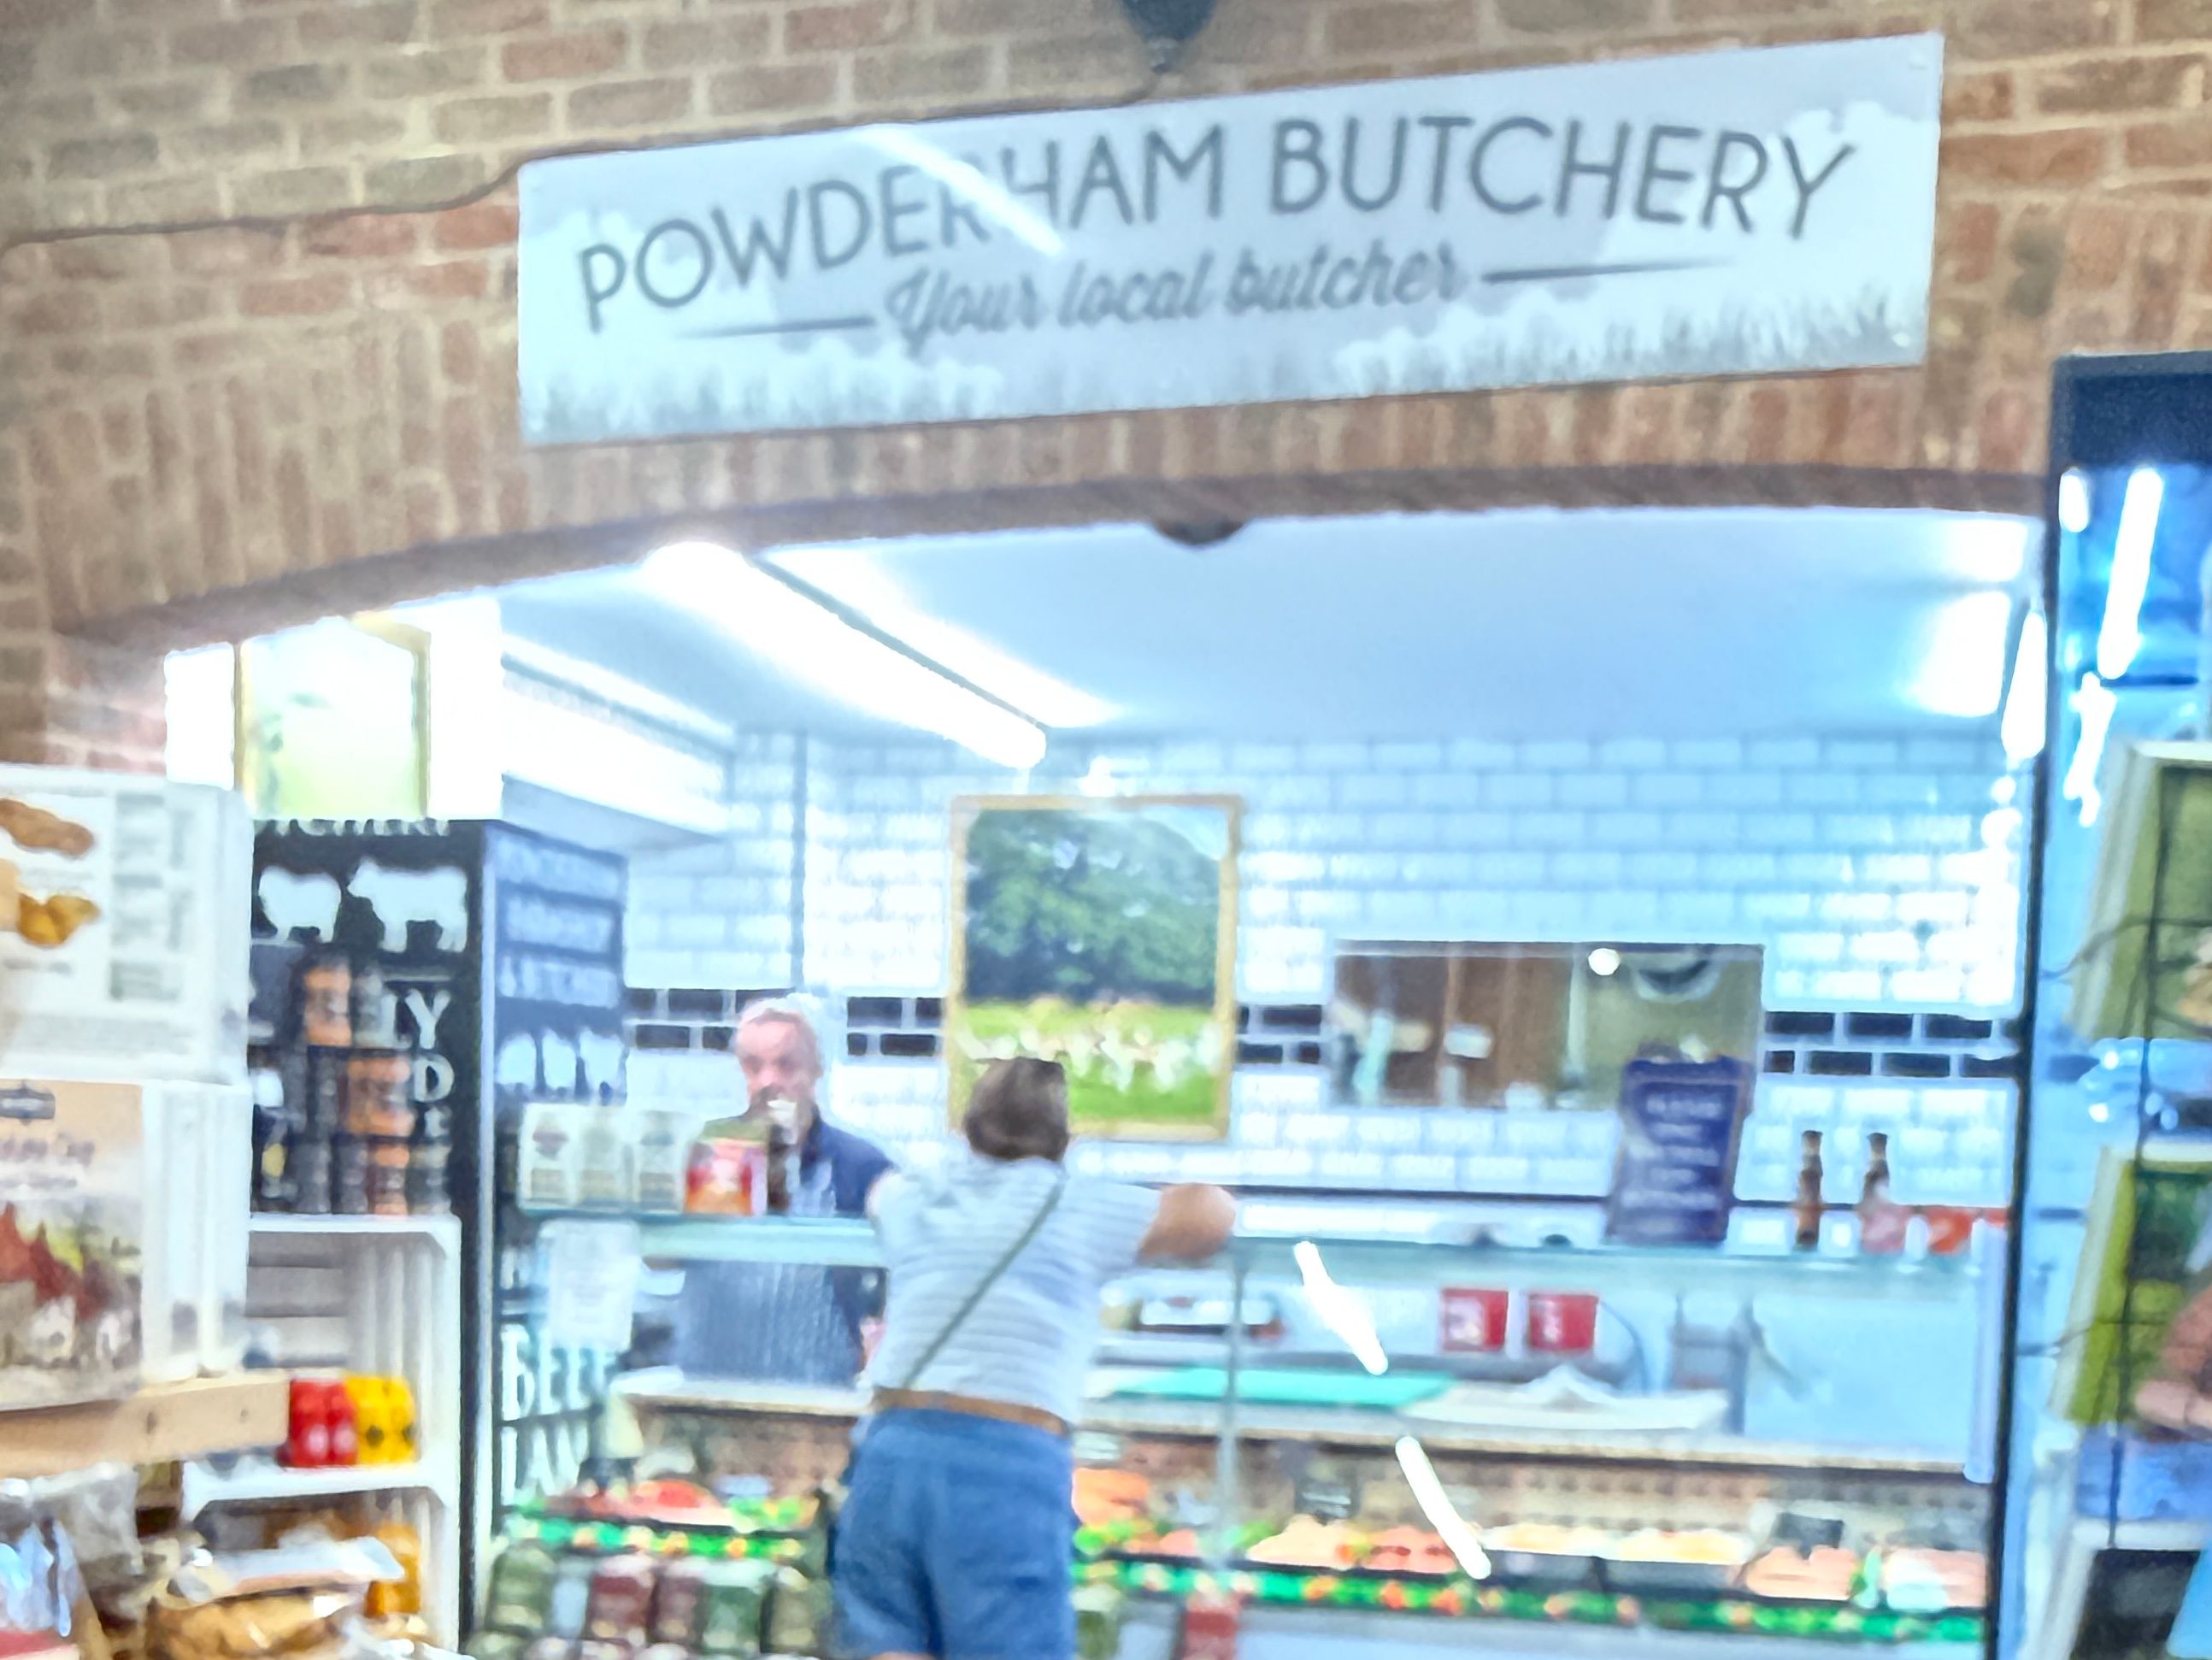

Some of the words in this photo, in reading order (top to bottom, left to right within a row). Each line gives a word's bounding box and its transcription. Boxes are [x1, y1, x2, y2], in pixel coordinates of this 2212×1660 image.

[1268, 114, 1858, 240] BUTCHERY
[884, 267, 1043, 358] Your
[1056, 250, 1217, 328] local
[1224, 237, 1463, 316] butcher
